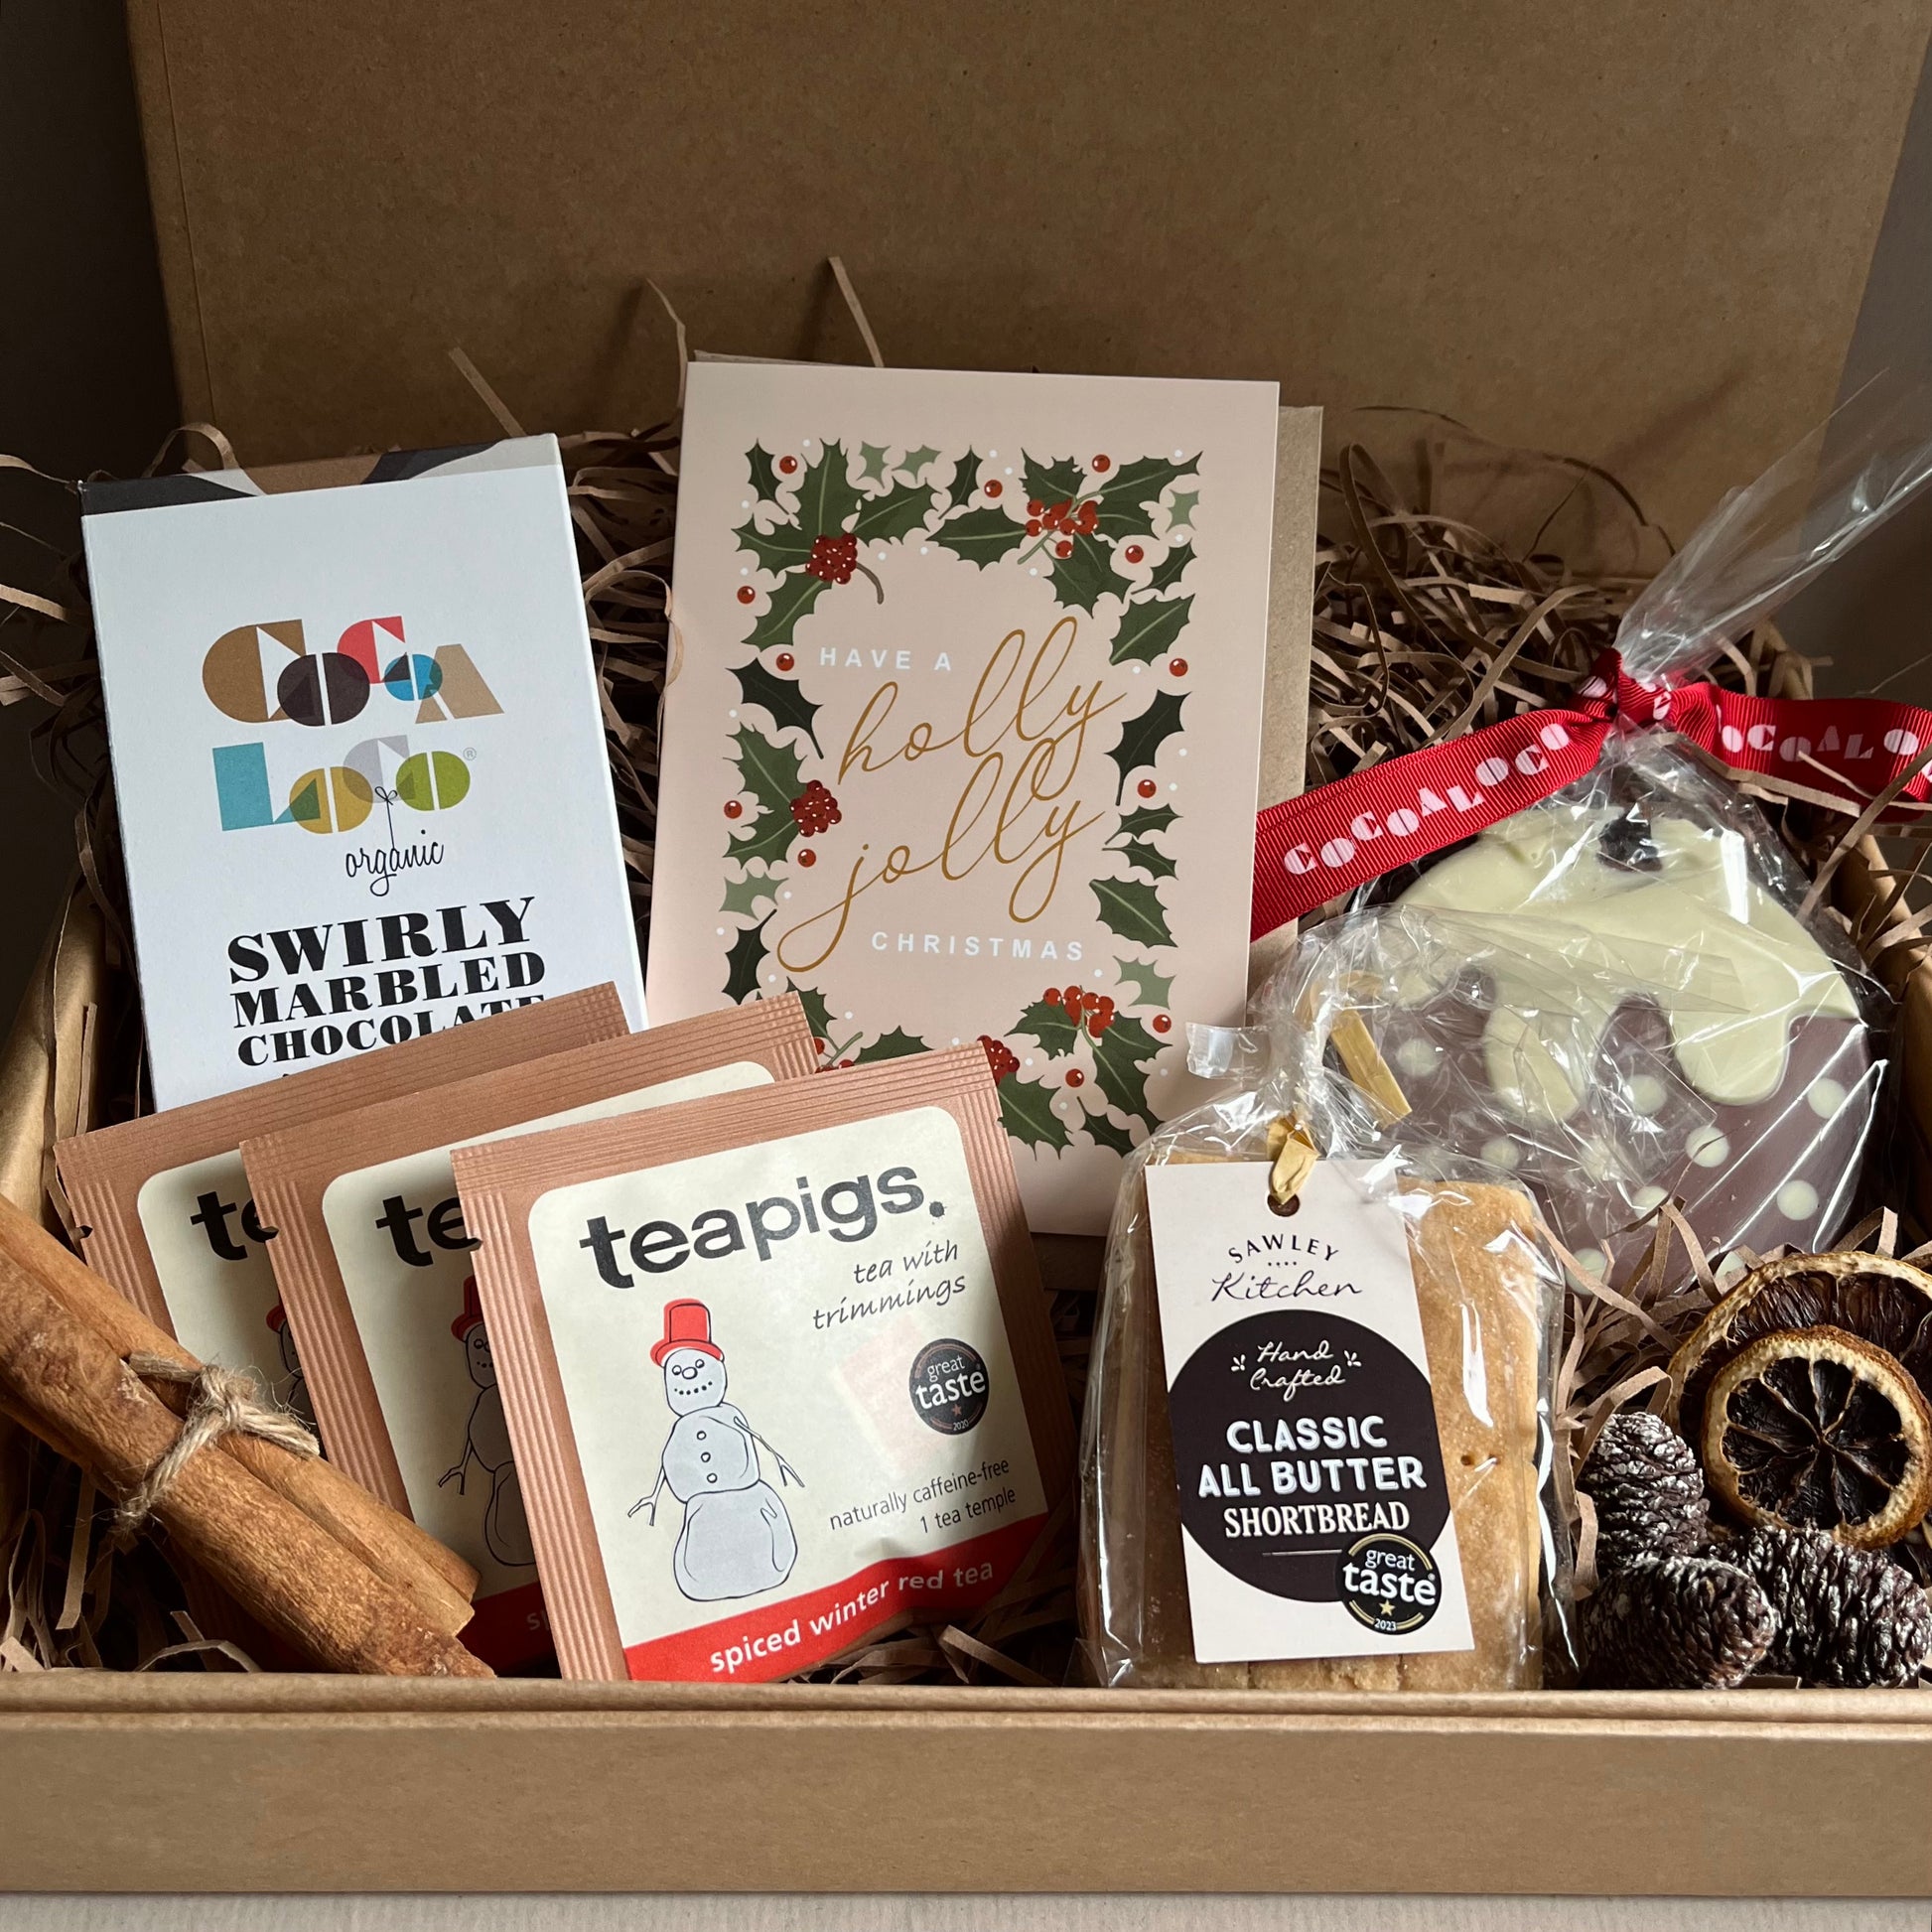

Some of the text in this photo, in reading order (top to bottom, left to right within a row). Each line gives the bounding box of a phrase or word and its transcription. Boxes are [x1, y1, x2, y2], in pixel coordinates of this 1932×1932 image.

[819, 646, 952, 671] HAVE A
[838, 616, 1127, 801] holly
[345, 830, 445, 897] organic
[776, 738, 1106, 973] jolly
[227, 896, 535, 984] SWIRLY
[871, 931, 1083, 960] CHRISTMAS
[229, 951, 545, 1029] MARBLED
[854, 1239, 958, 1284] tea with
[1228, 1233, 1339, 1263] SAWLEY
[813, 1274, 966, 1329] trimmings
[1211, 1270, 1363, 1302] Kitchen
[927, 1354, 965, 1383] great
[1257, 1339, 1334, 1363] Hand
[914, 1370, 986, 1410] taste
[1250, 1364, 1346, 1402] Crafted
[952, 1419, 969, 1432] 2020
[1226, 1415, 1388, 1453] CLASSIC
[829, 1457, 1010, 1530] naturally caffeine-free
[1197, 1455, 1428, 1498] ALL BUTTER
[919, 1486, 1017, 1534] 1 tea temple
[1223, 1501, 1410, 1538] SHORTBREAD
[1365, 1549, 1415, 1572] great
[1342, 1562, 1437, 1606] taste
[710, 1561, 993, 1675] spiced winter red tea
[1373, 1617, 1398, 1631] 2023
